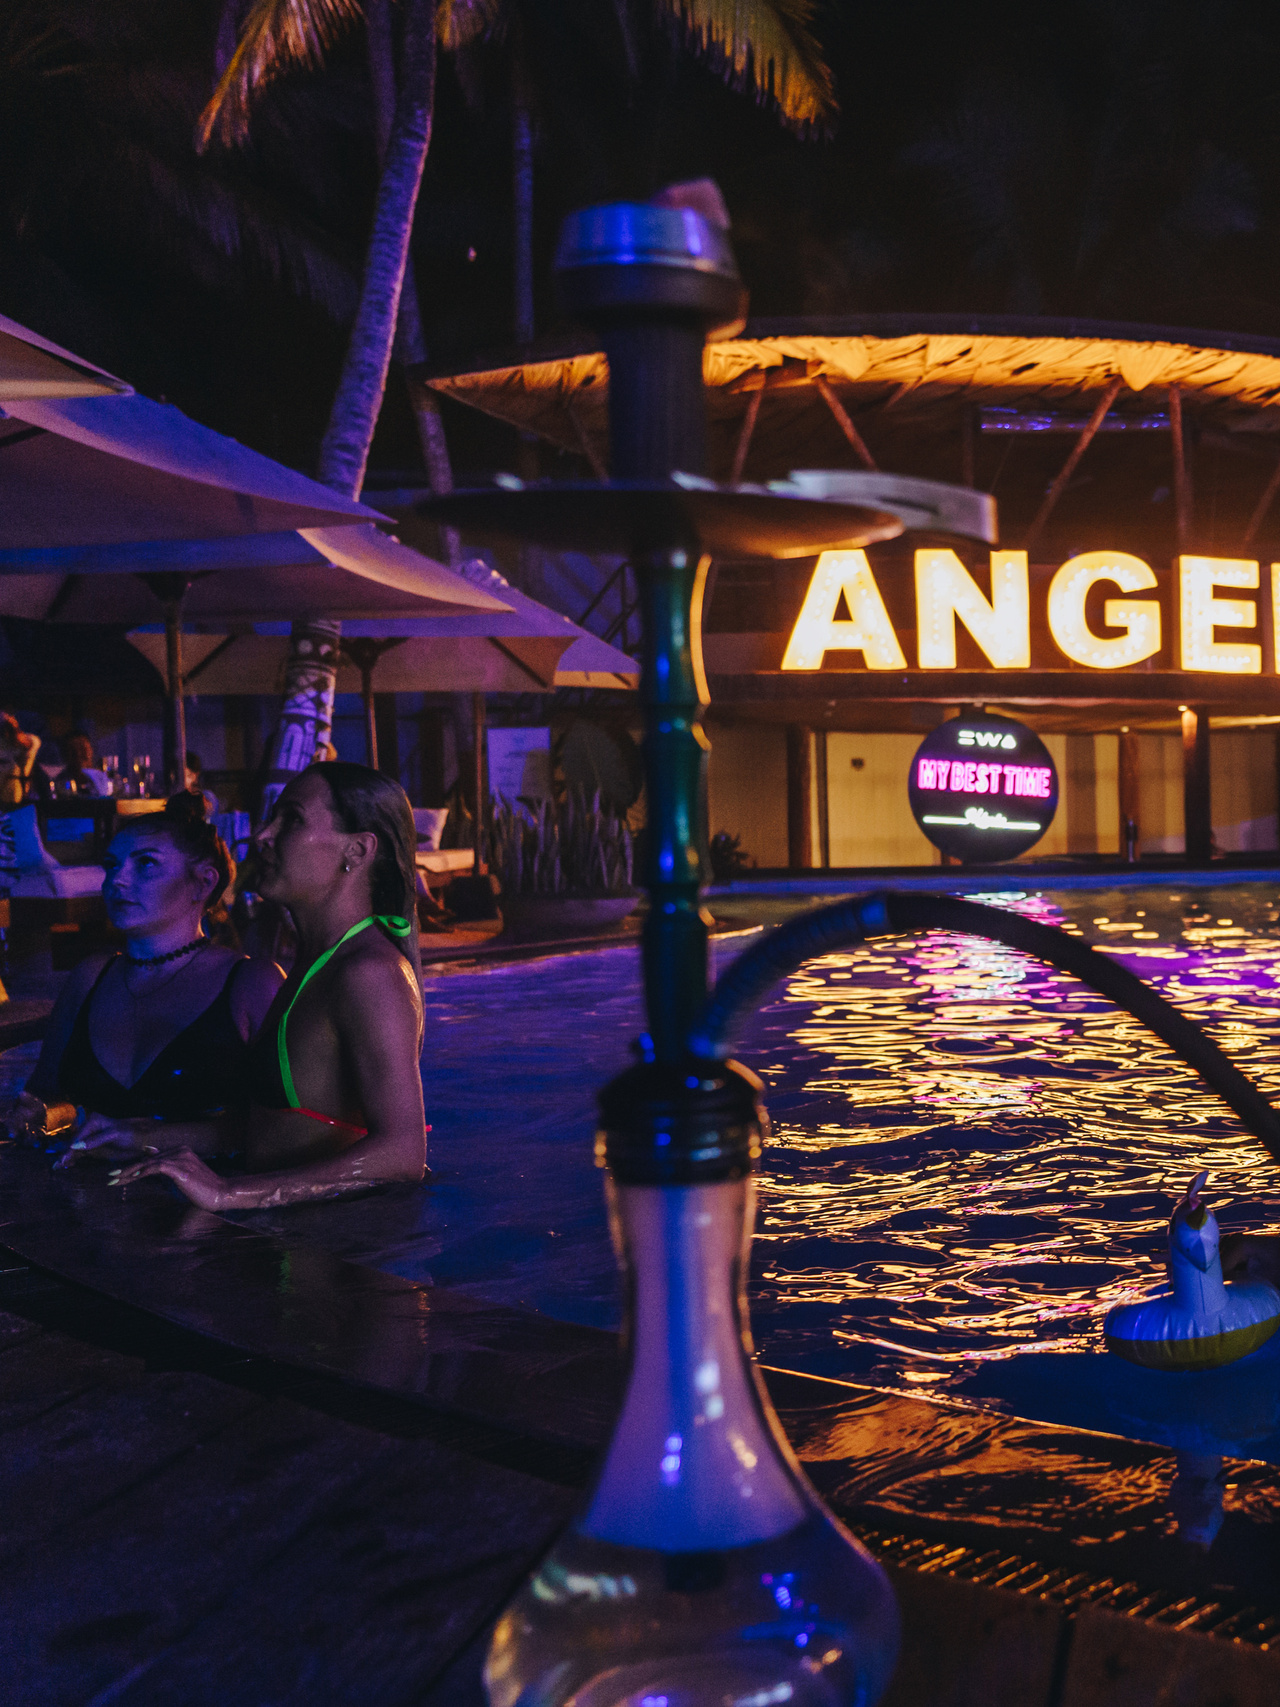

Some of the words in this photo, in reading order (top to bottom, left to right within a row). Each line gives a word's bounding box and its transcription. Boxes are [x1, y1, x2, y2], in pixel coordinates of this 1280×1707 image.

[917, 758, 951, 791] MY
[950, 760, 1003, 795] BEST
[1003, 764, 1052, 798] TIME
